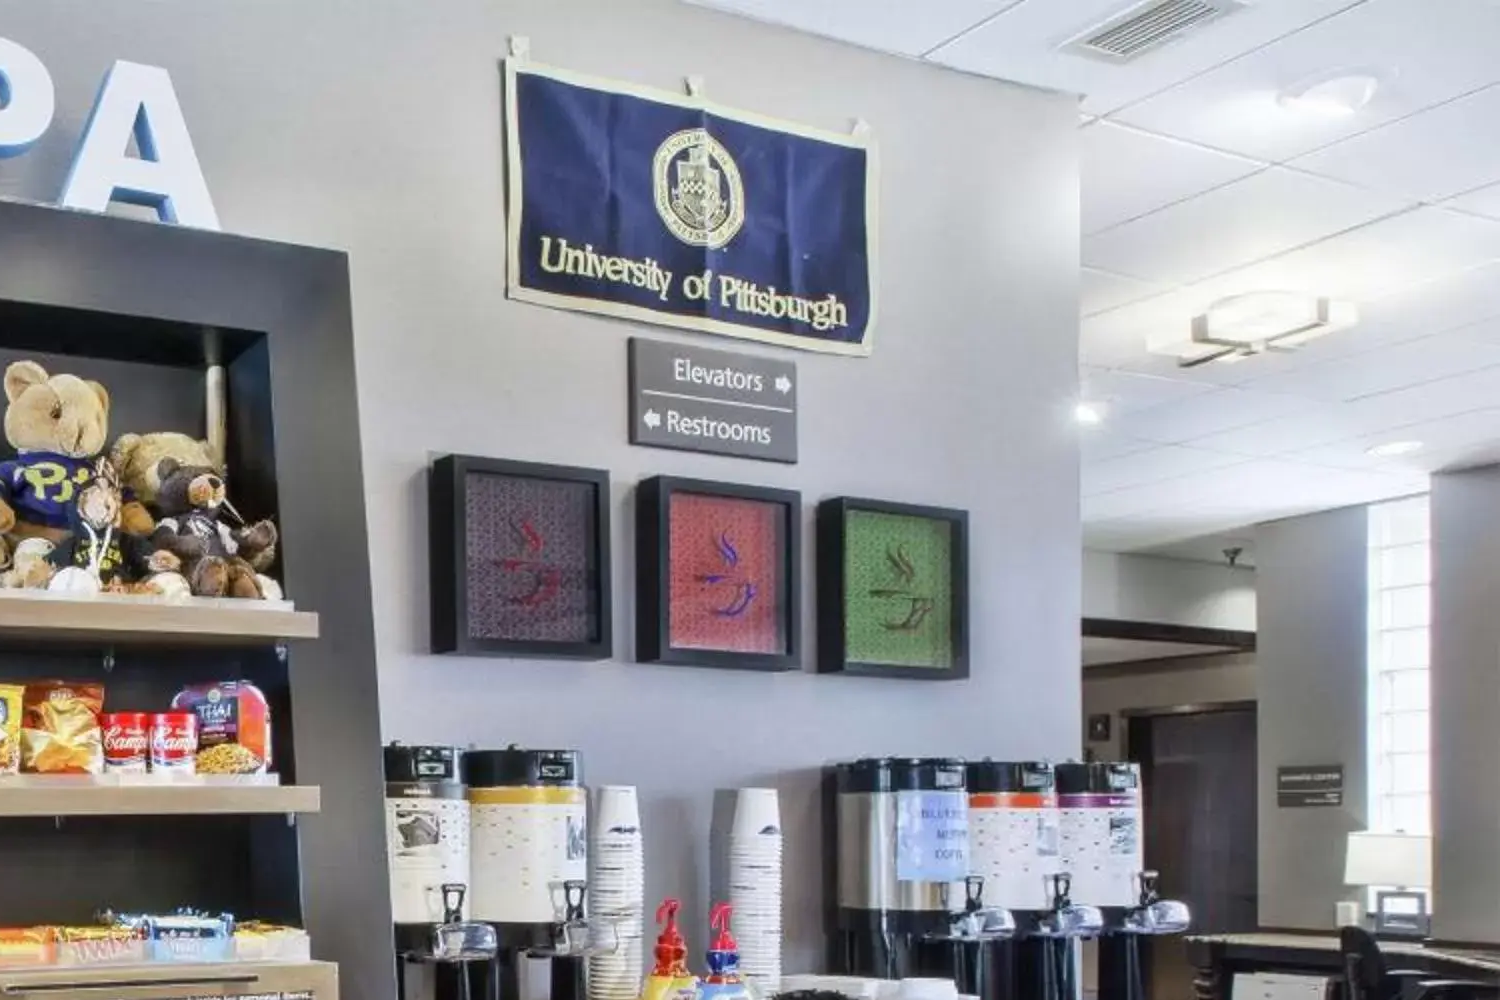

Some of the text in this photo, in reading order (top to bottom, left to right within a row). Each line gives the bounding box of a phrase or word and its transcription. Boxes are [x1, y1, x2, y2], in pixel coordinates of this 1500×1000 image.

[540, 235, 848, 331] University of Pittsburgh
[674, 358, 763, 392] Elevators
[667, 410, 772, 444] Restrooms
